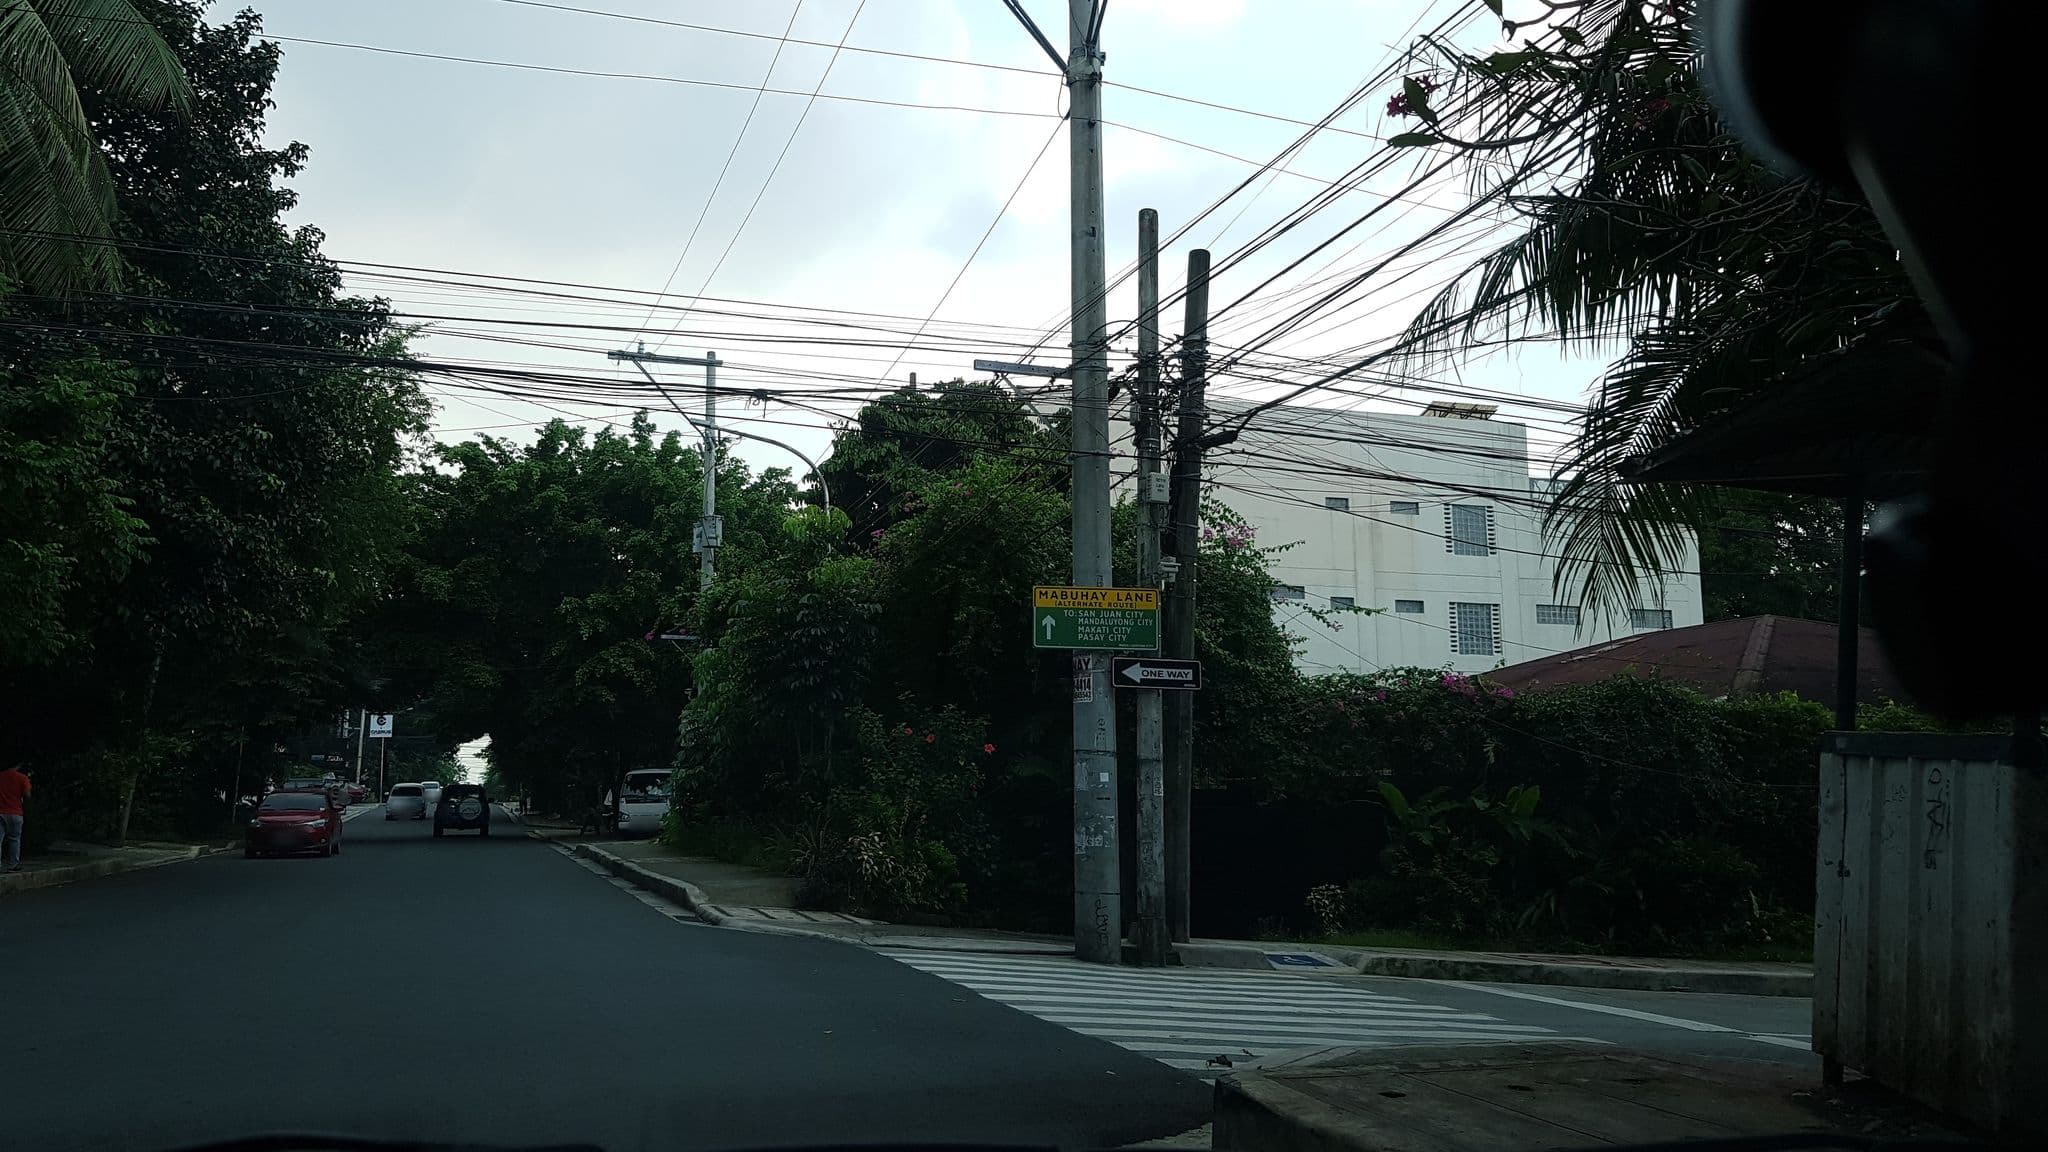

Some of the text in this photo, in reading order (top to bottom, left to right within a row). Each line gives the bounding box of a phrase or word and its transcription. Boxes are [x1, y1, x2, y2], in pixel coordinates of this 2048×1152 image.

[1039, 590, 1153, 603] MABUHAY LANE
[1107, 601, 1137, 609] ROUTE)
[1063, 609, 1144, 619] TO: SAN JUAN CITY
[1078, 618, 1153, 627] MANDALUYONG CITY
[1078, 626, 1132, 634] MAKATI CITY
[1108, 634, 1128, 642] CITY
[1141, 669, 1190, 679] ONE WAY
